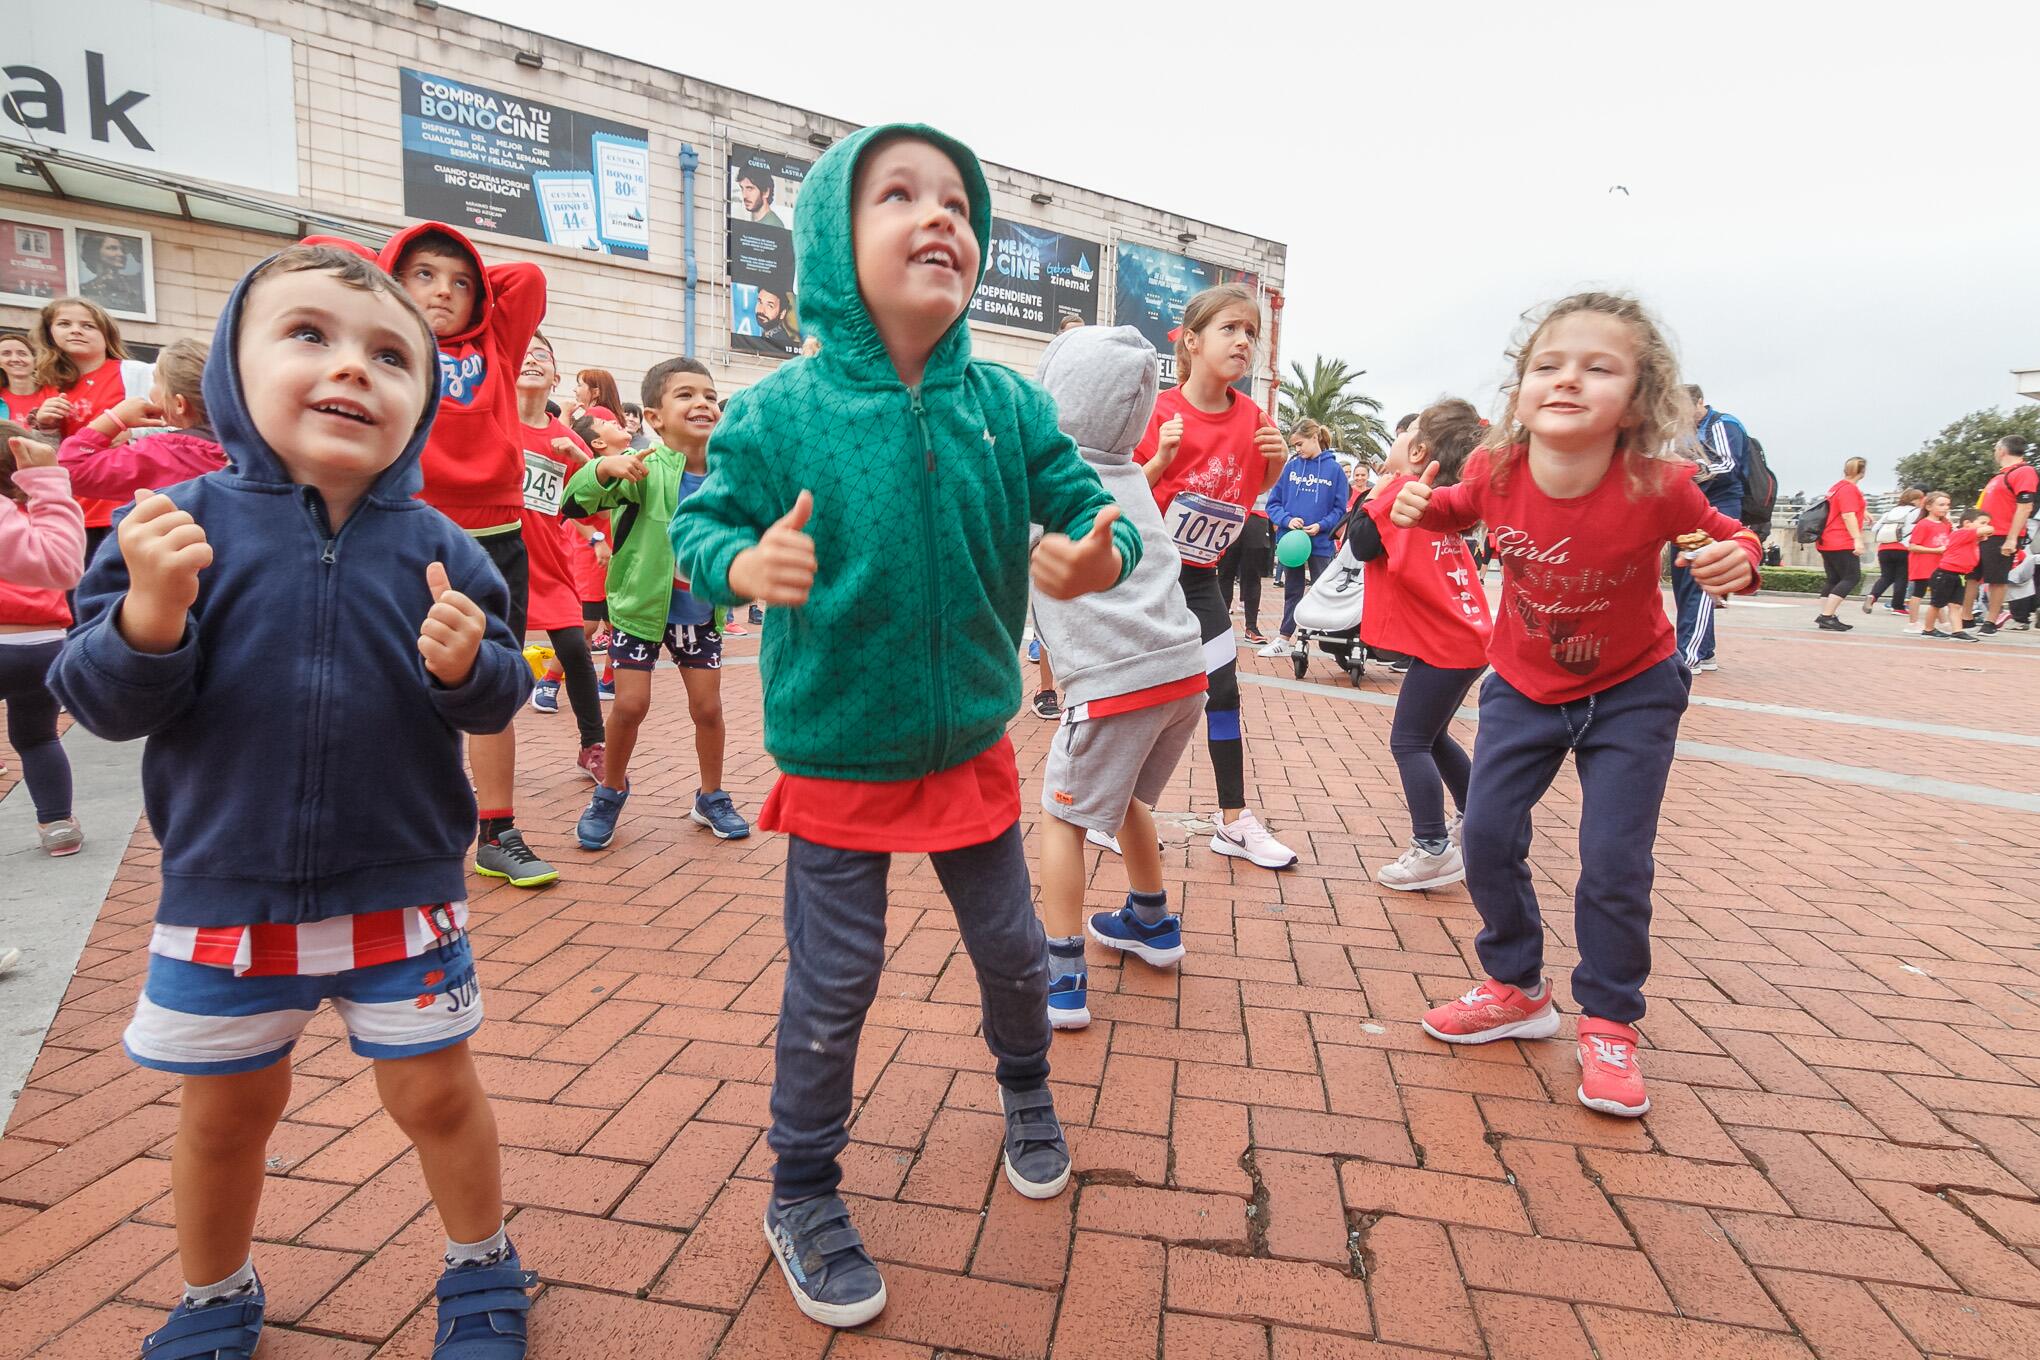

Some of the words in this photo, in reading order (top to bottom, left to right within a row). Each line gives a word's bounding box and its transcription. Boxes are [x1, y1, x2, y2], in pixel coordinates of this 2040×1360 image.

[2, 50, 154, 152] ak
[421, 81, 499, 112] COMPRA
[502, 100, 525, 118] YA
[528, 107, 551, 124] TU
[420, 95, 549, 143] BONOCINE
[421, 122, 461, 137] DISFRUTA
[471, 133, 486, 143] DEL
[496, 139, 523, 151] MEJOR
[532, 147, 550, 158] CINE
[421, 132, 469, 149] CUALQUIER
[472, 142, 487, 153] DÍA
[489, 146, 500, 156] DE
[502, 148, 513, 159] LA
[450, 147, 479, 161] SESIÓN
[480, 154, 487, 162] Y
[488, 155, 525, 171] PELÍCULA
[748, 159, 771, 170] CUESTA
[434, 164, 468, 178] CUANDO
[468, 171, 500, 184] QUIERAS
[501, 178, 531, 191] PORQUE
[606, 169, 632, 180] BONO
[781, 167, 804, 178] LASTRA
[468, 179, 521, 198] CADUCA!
[553, 203, 580, 211] BONO
[998, 239, 1040, 261] MEJOR
[996, 253, 1041, 280] CINE
[1050, 273, 1090, 293] zinemak
[975, 284, 1043, 307] NDEPENDIENTE
[969, 298, 982, 310] DE
[984, 300, 1020, 318] ESPAÑA
[1022, 308, 1044, 322] 2016
[1173, 511, 1236, 551] 1015
[1495, 525, 1571, 564] Girls
